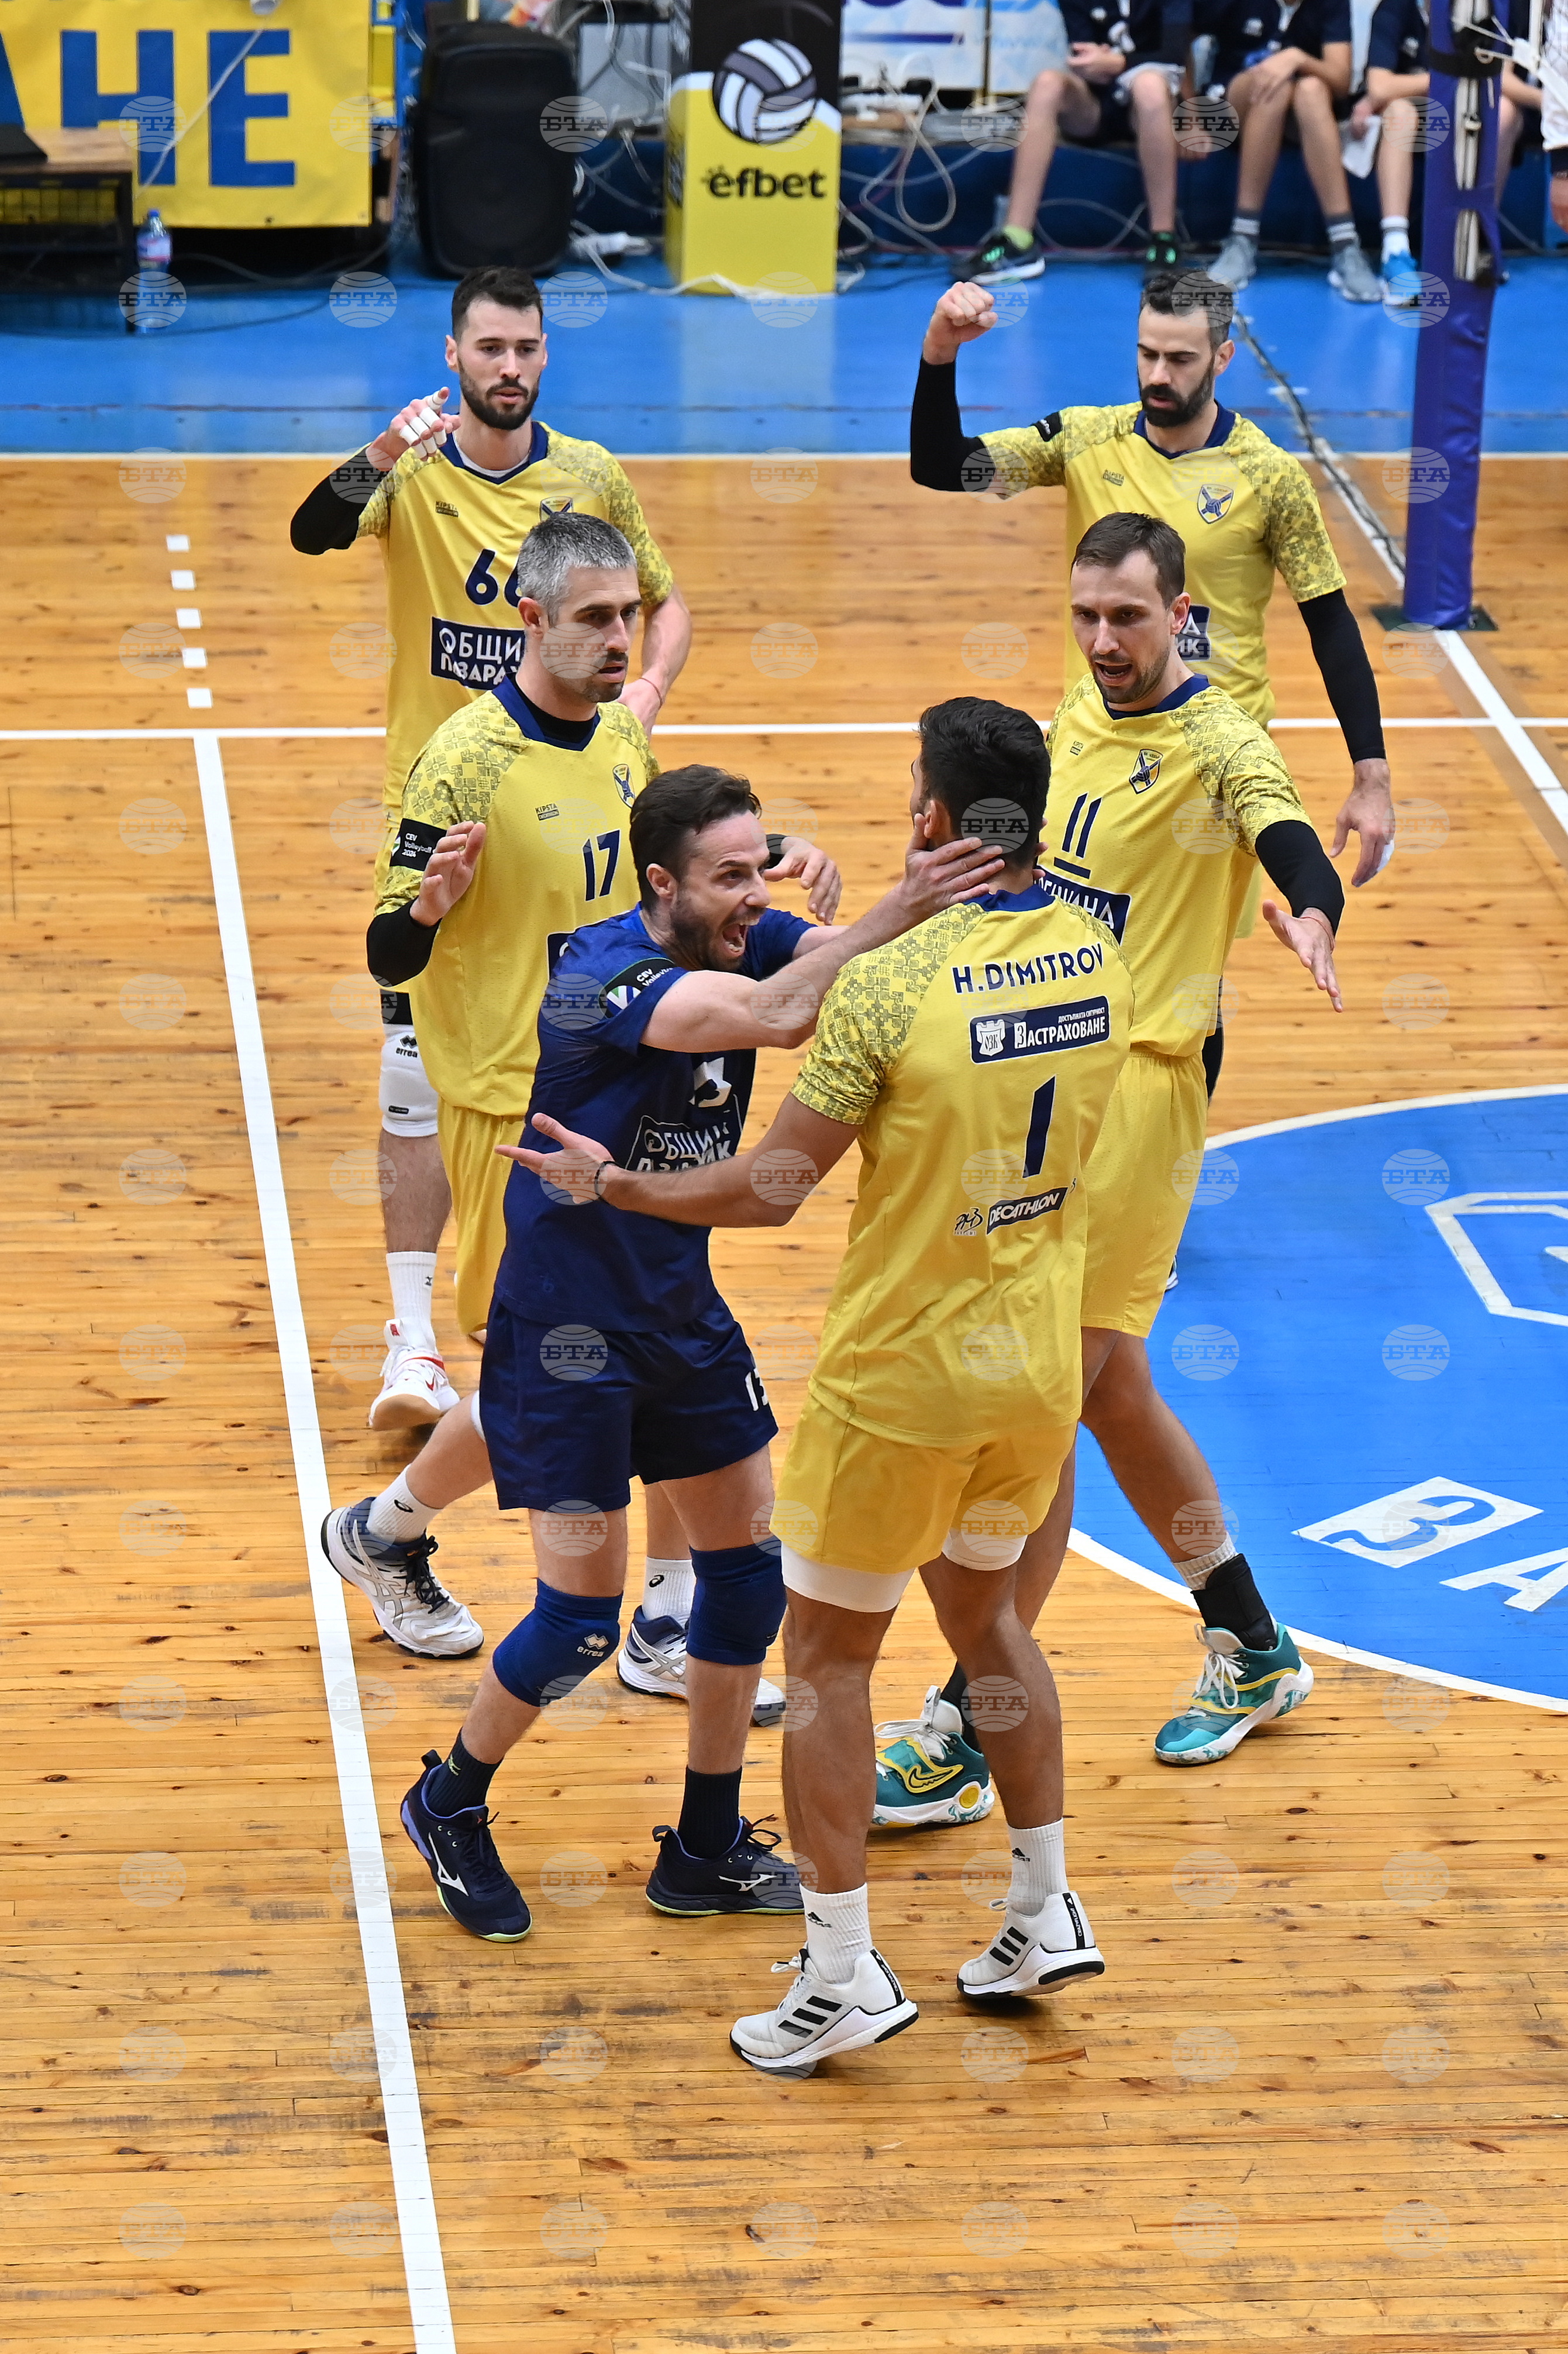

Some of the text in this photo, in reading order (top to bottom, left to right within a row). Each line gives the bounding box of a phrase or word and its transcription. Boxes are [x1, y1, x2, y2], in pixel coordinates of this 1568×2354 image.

[708, 166, 826, 198] efbet
[535, 803, 557, 814] KIPSTA
[405, 832, 418, 841] CEV
[1062, 793, 1096, 858] 11
[404, 841, 432, 854] Volleyball
[583, 830, 621, 901] 17
[636, 968, 653, 982] CEV
[952, 943, 1103, 994] H.DIMITROV
[1014, 1016, 1105, 1049] ЗАСТРАХОВАНЕ
[1022, 1075, 1056, 1178] 1
[988, 1192, 1060, 1226] DECATHLON
